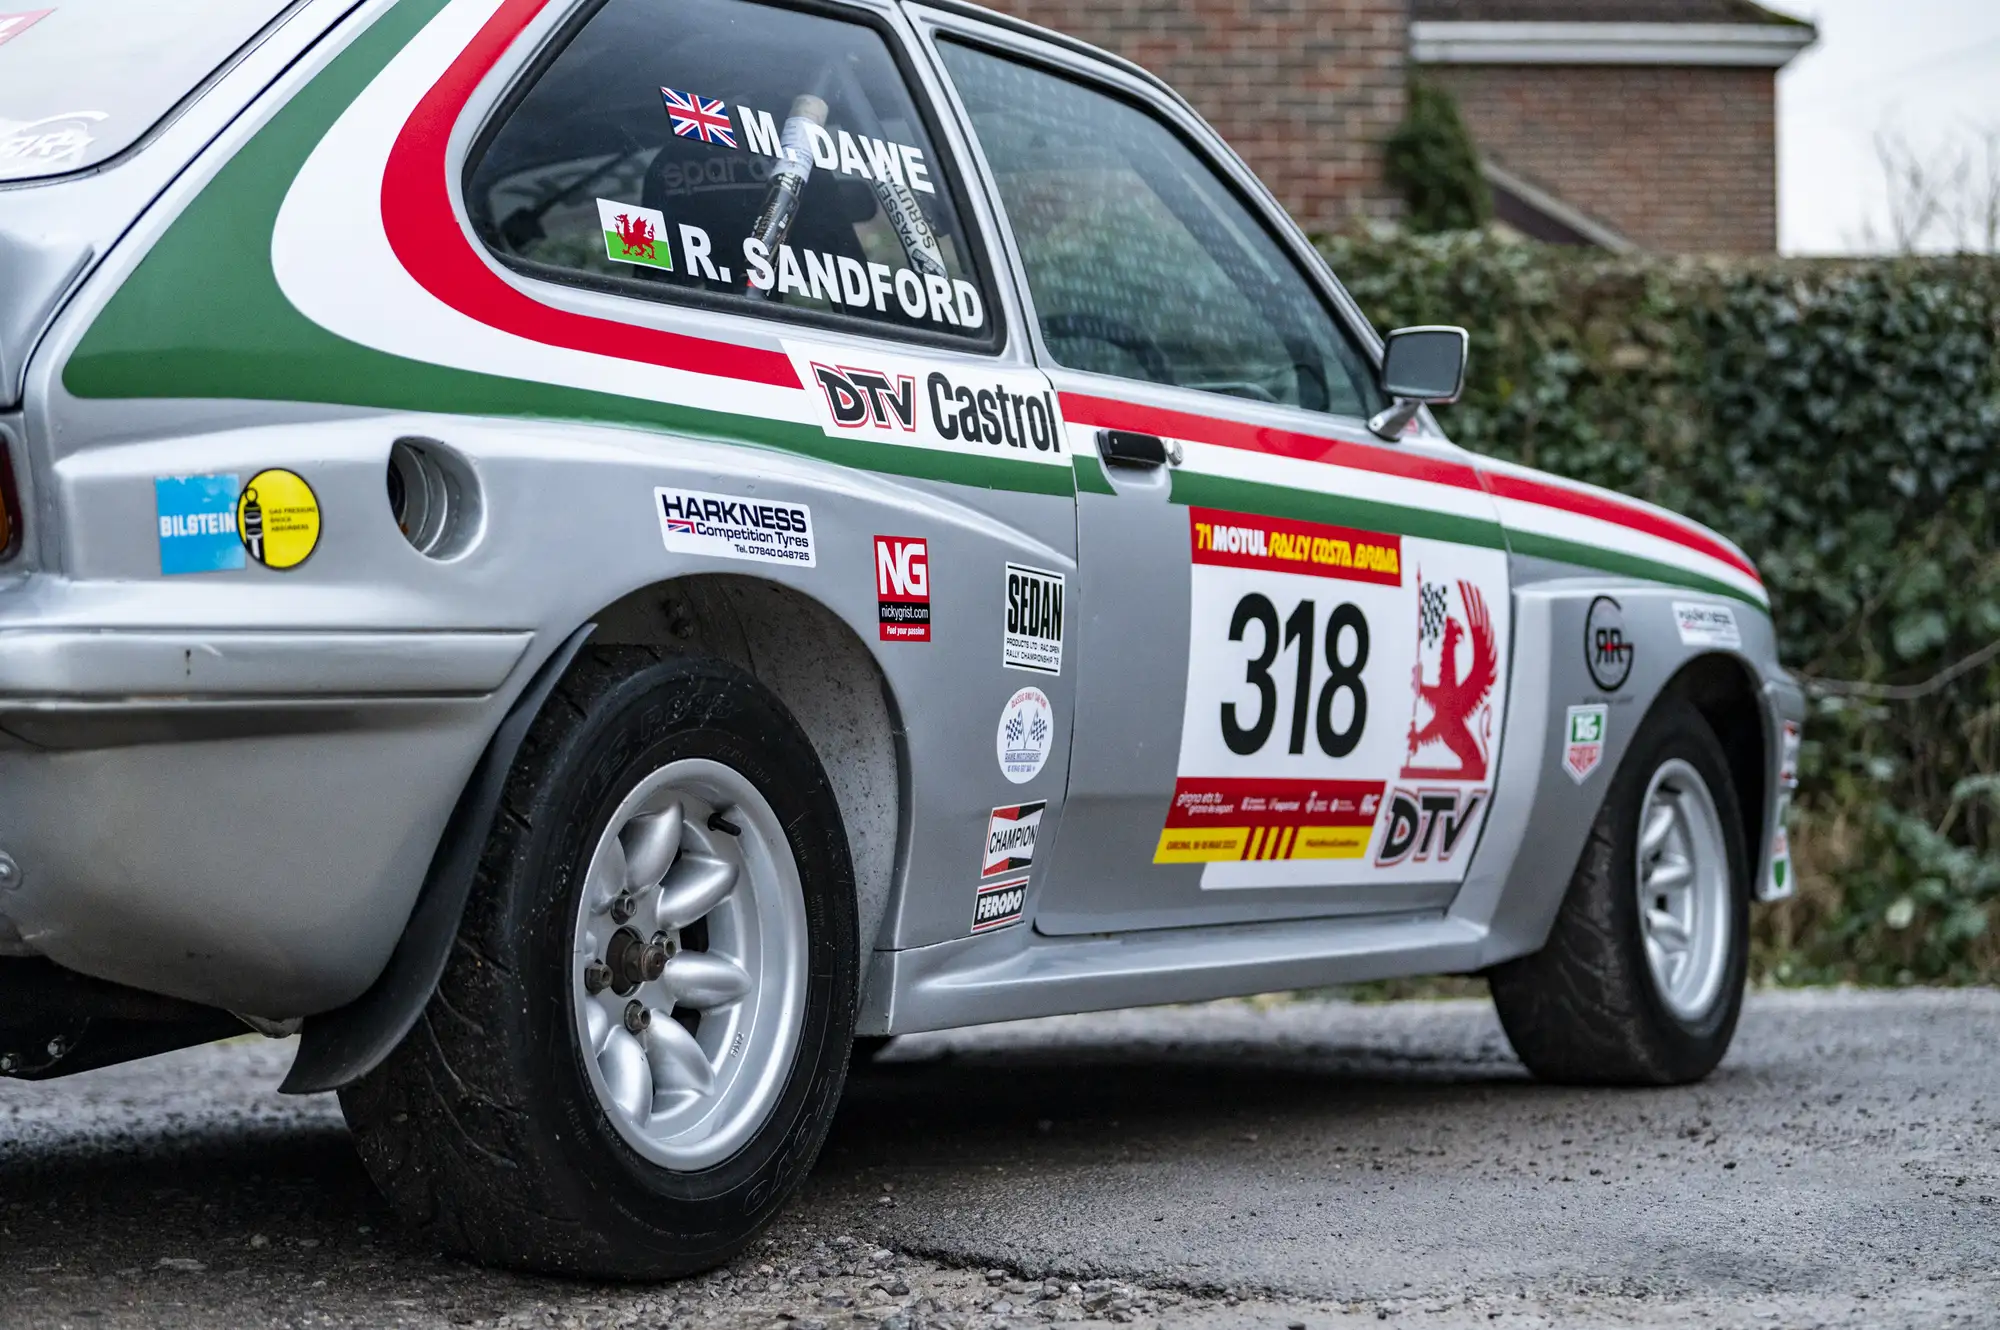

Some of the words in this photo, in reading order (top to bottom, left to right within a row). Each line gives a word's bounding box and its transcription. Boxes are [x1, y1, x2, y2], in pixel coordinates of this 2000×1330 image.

[736, 105, 799, 162] M.
[804, 121, 935, 194] DAWE
[678, 223, 732, 283] R.
[743, 236, 984, 329] SANDFORD
[810, 360, 916, 433] DTV
[927, 371, 1061, 453] Castrol
[160, 511, 237, 538] BILSTEIN
[661, 493, 807, 533] HARKNESS
[696, 521, 774, 544] Competition
[774, 531, 809, 549] Tyres
[734, 543, 748, 554] Tel.
[748, 545, 777, 557] 07840
[777, 549, 810, 561] 048725
[1195, 523, 1212, 550] 71
[1212, 524, 1269, 557] MOTUL
[1268, 531, 1311, 562] RALLY
[1311, 537, 1353, 567] COSTA
[877, 541, 928, 597] NG
[881, 604, 929, 622] nickygrist.com
[1008, 573, 1063, 642] SEDAN
[897, 627, 908, 637] your
[907, 626, 925, 637] passion
[1006, 637, 1030, 649] PRODUCTS
[1040, 643, 1049, 652] RAC
[1049, 645, 1060, 654] OPEN
[1005, 648, 1020, 658] RALLY
[1021, 651, 1053, 664] CHAMPIONSHIP
[1221, 592, 1370, 758] 318
[989, 824, 1039, 854] CHAMPION
[1374, 786, 1489, 868] DTV
[977, 889, 1023, 920] FERODO
